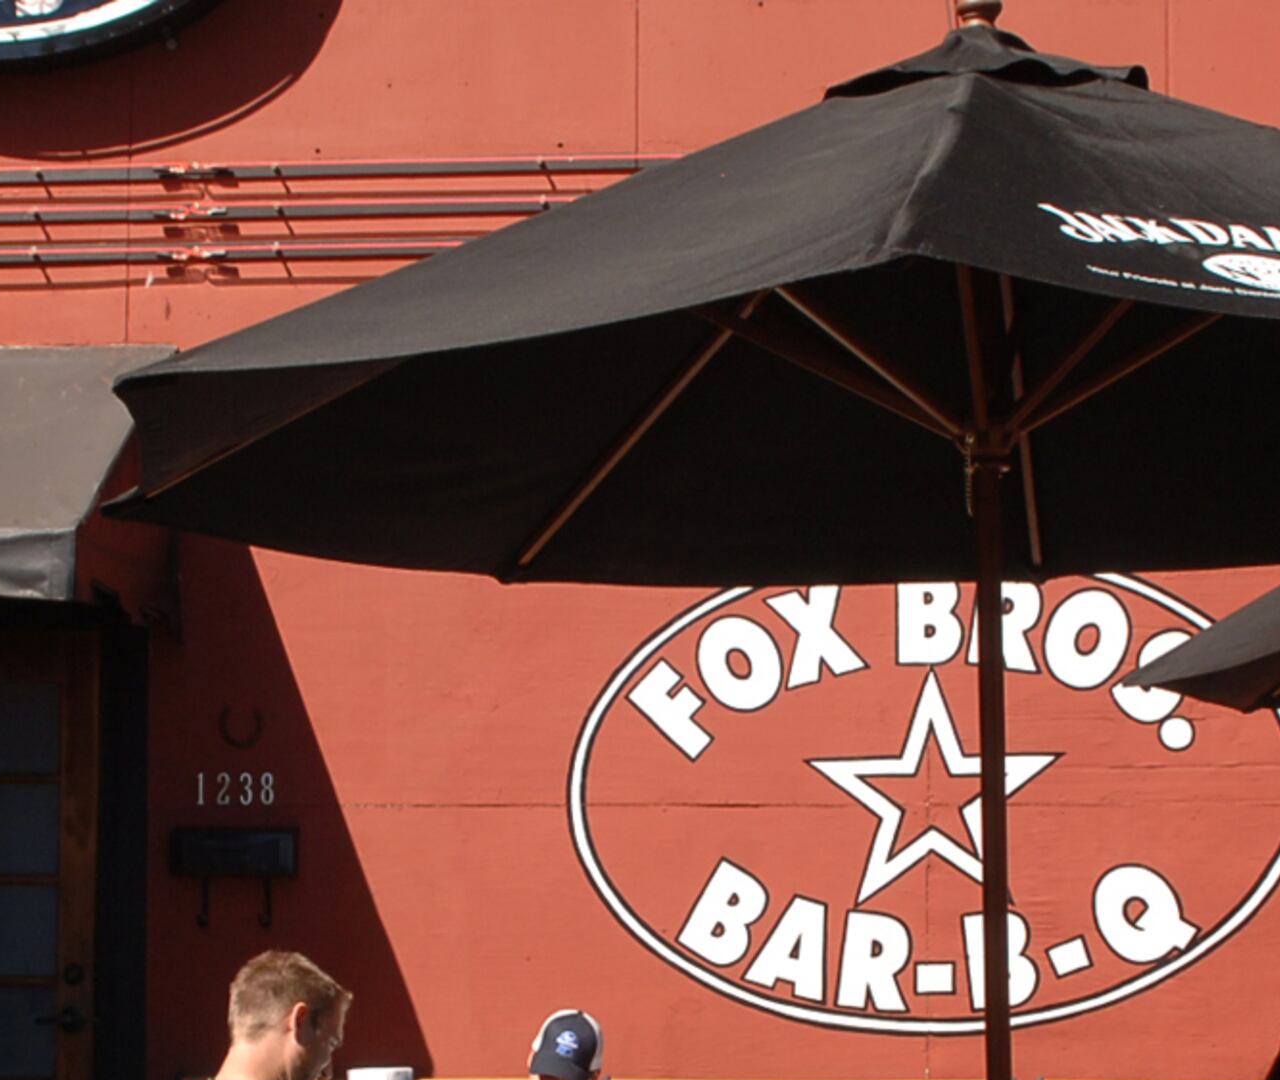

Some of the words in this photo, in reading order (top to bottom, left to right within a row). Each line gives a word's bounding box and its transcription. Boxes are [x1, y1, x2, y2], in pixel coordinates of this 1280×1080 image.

[628, 585, 868, 760] FOX
[196, 771, 275, 806] 1238
[677, 857, 1201, 1014] BAR-B-Q
